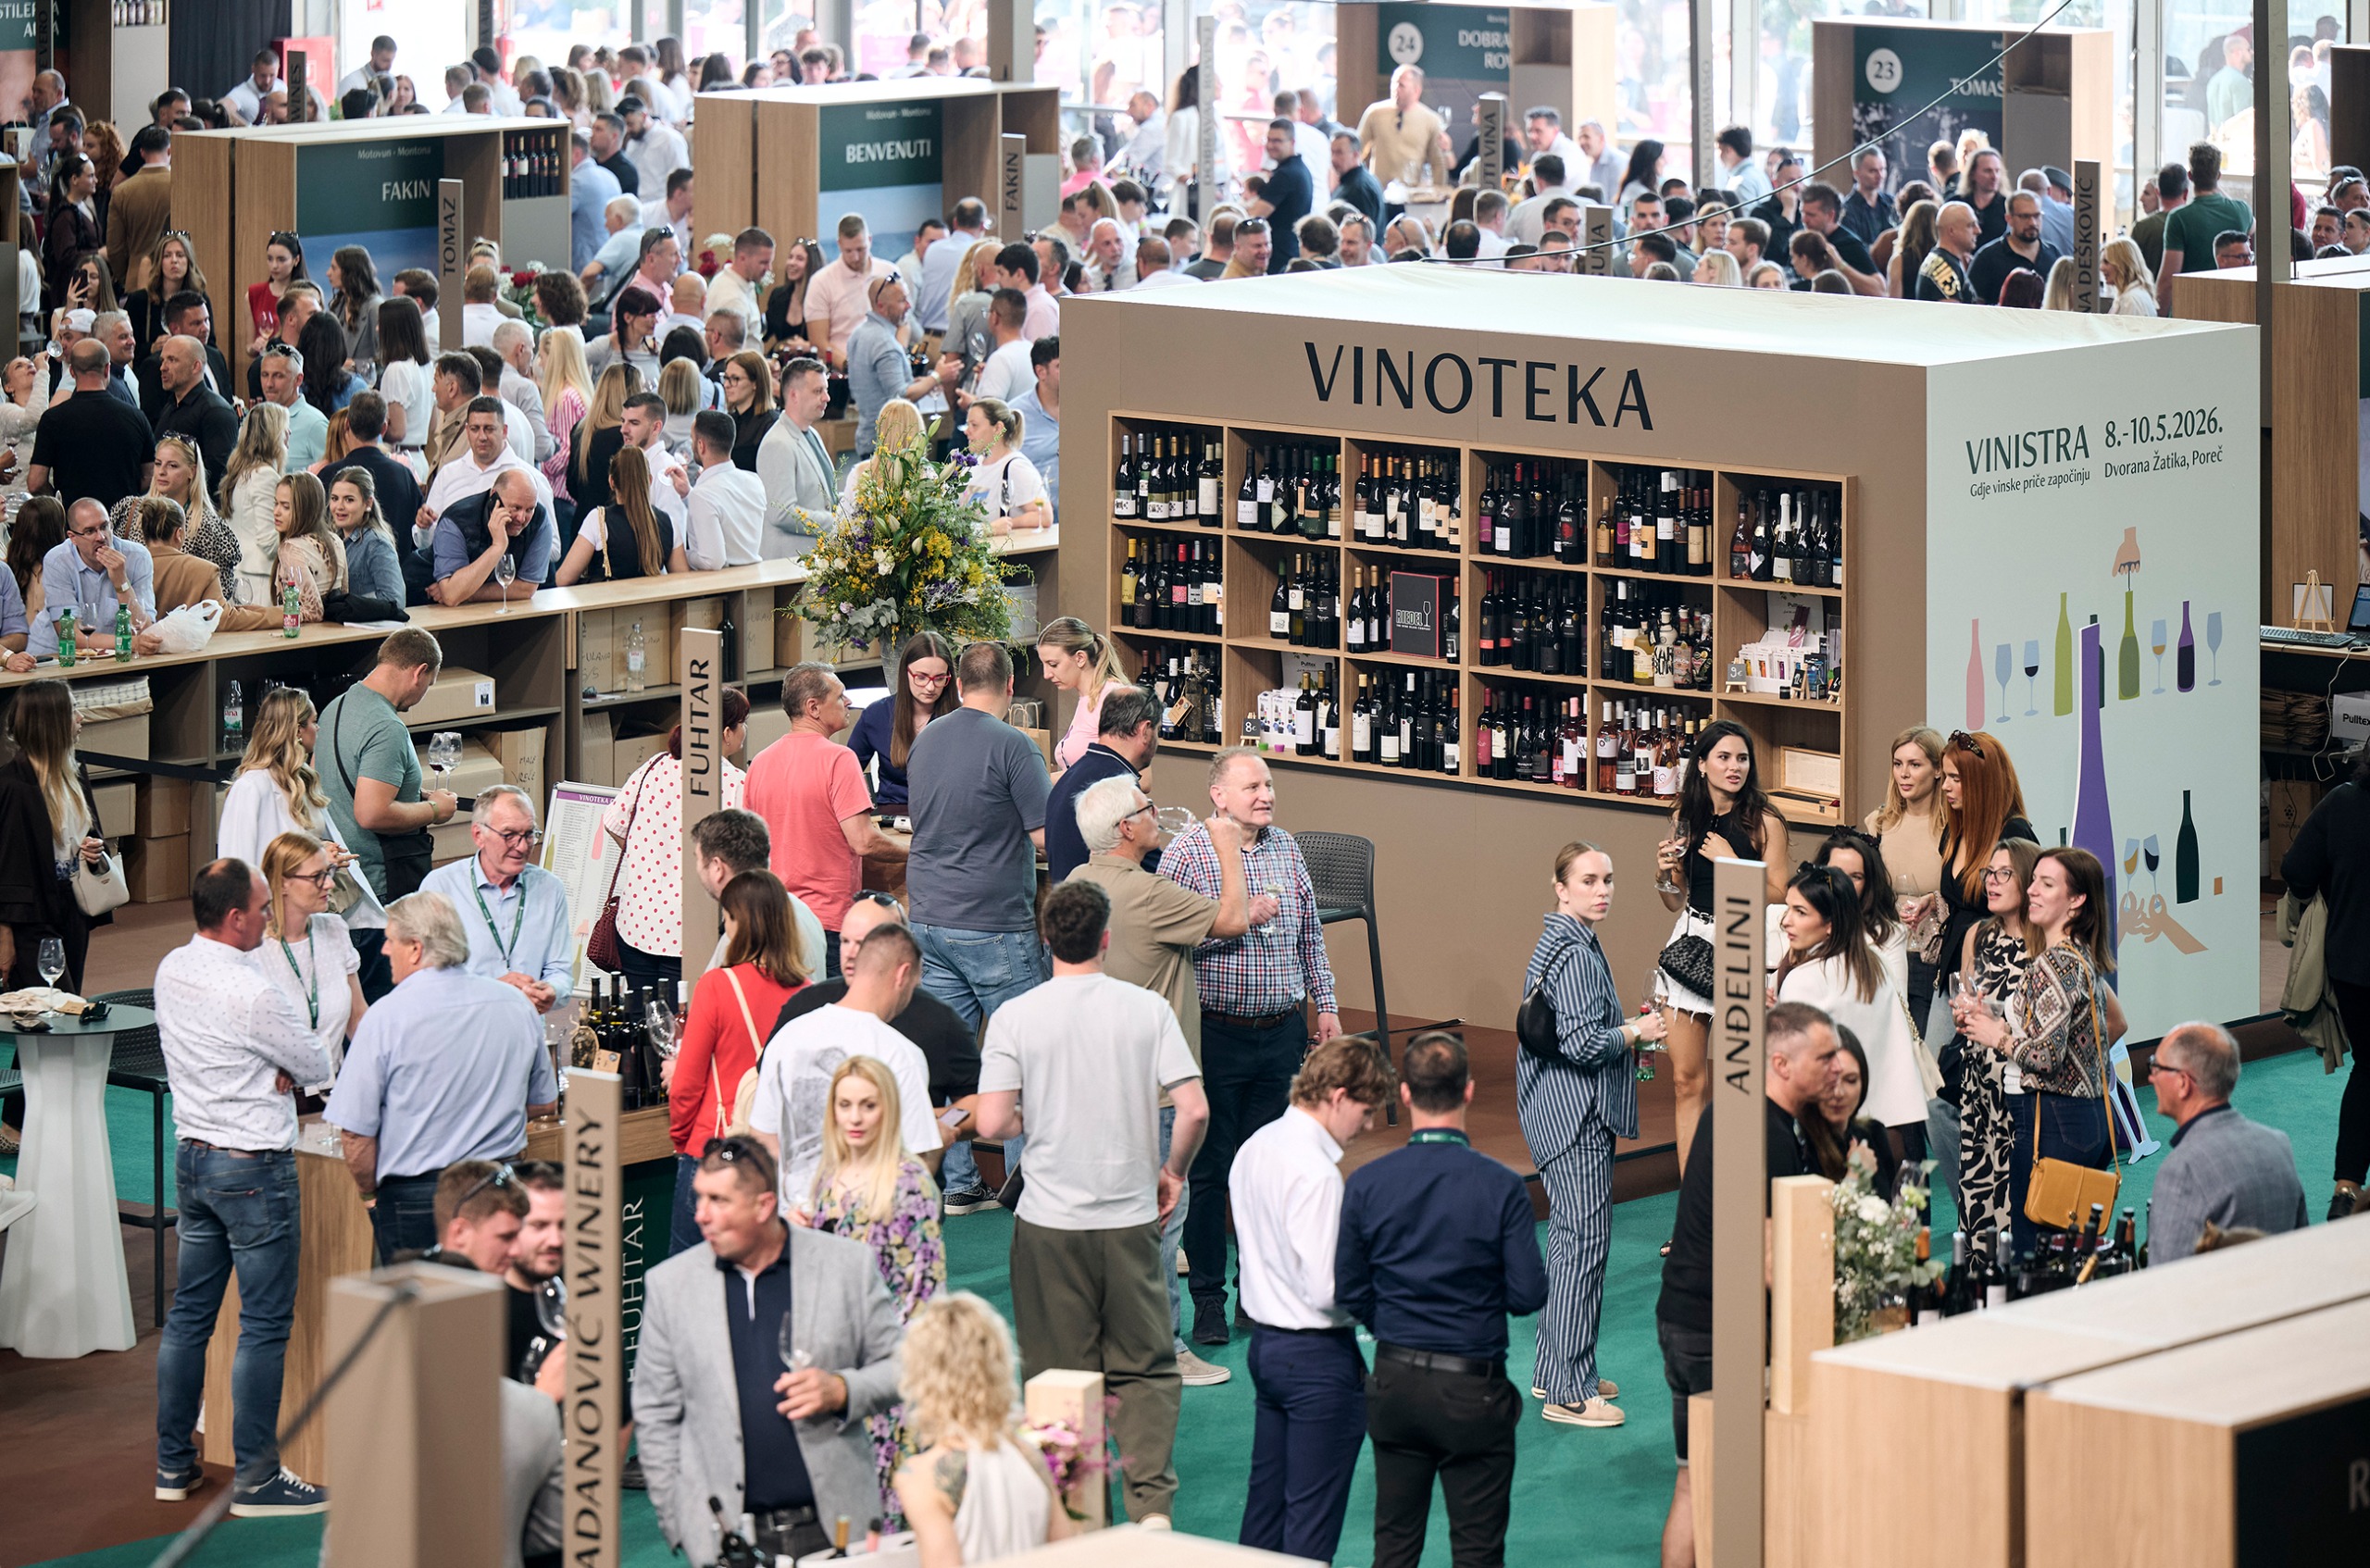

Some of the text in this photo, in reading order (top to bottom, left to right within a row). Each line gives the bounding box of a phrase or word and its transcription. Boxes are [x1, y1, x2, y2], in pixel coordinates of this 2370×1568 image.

[39, 10, 48, 55] VERO
[1396, 36, 1416, 53] 24
[1874, 61, 1894, 80] 23
[357, 148, 392, 159] Motovun
[846, 139, 931, 163] BENVENUTI
[1484, 112, 1496, 156] VINA
[381, 180, 430, 201] FAKIN
[1005, 152, 1018, 211] FAKIN
[443, 197, 455, 276] TOMAZ
[2074, 178, 2093, 285] DEŠKOVIĆ
[1304, 341, 1654, 431] VINOTEKA
[2104, 406, 2224, 448] 8.-10.5.2026.
[1965, 424, 2090, 475] VINISTRA
[2104, 445, 2223, 478] Dvorana Žatika, Poreč
[1969, 467, 2090, 500] Gdje vinske priče započinju
[1396, 609, 1423, 627] RIEDEL
[690, 658, 710, 797] FUHTAR
[579, 794, 609, 804] VINOTEKA
[1725, 896, 1751, 1095] ANĐELINI
[576, 1107, 603, 1298] WINERY
